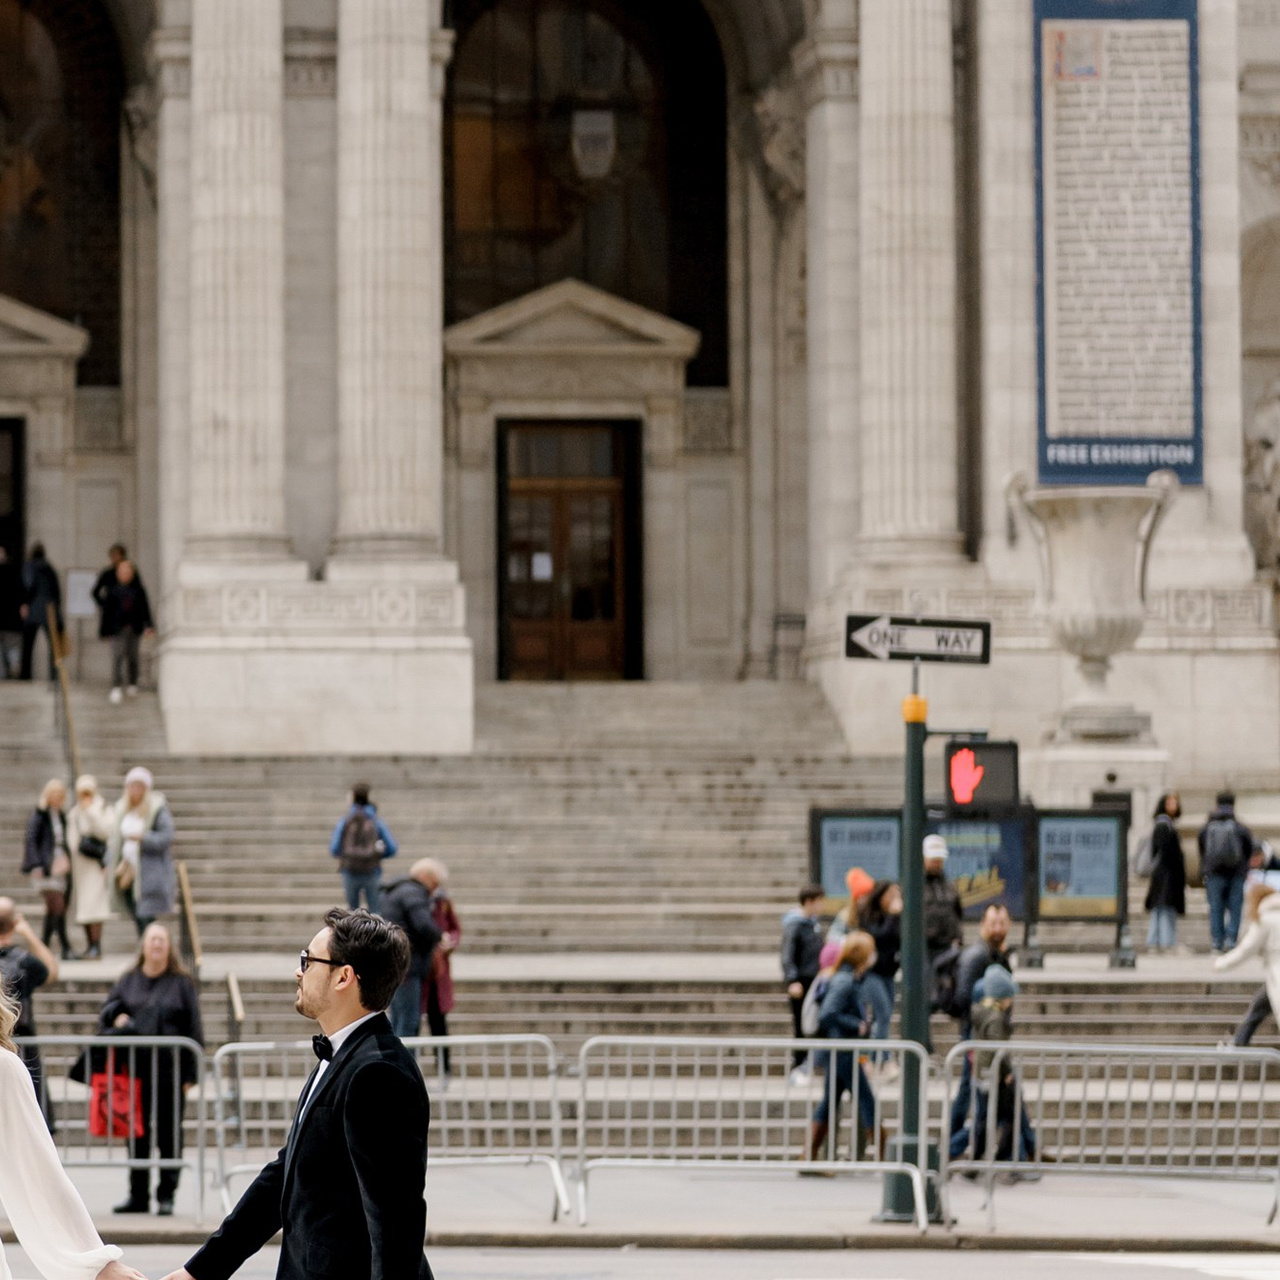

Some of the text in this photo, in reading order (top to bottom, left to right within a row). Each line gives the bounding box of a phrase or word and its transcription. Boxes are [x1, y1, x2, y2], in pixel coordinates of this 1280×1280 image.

[1047, 444, 1194, 464] FREE EXHIBITION
[869, 627, 975, 650] ONE WAY
